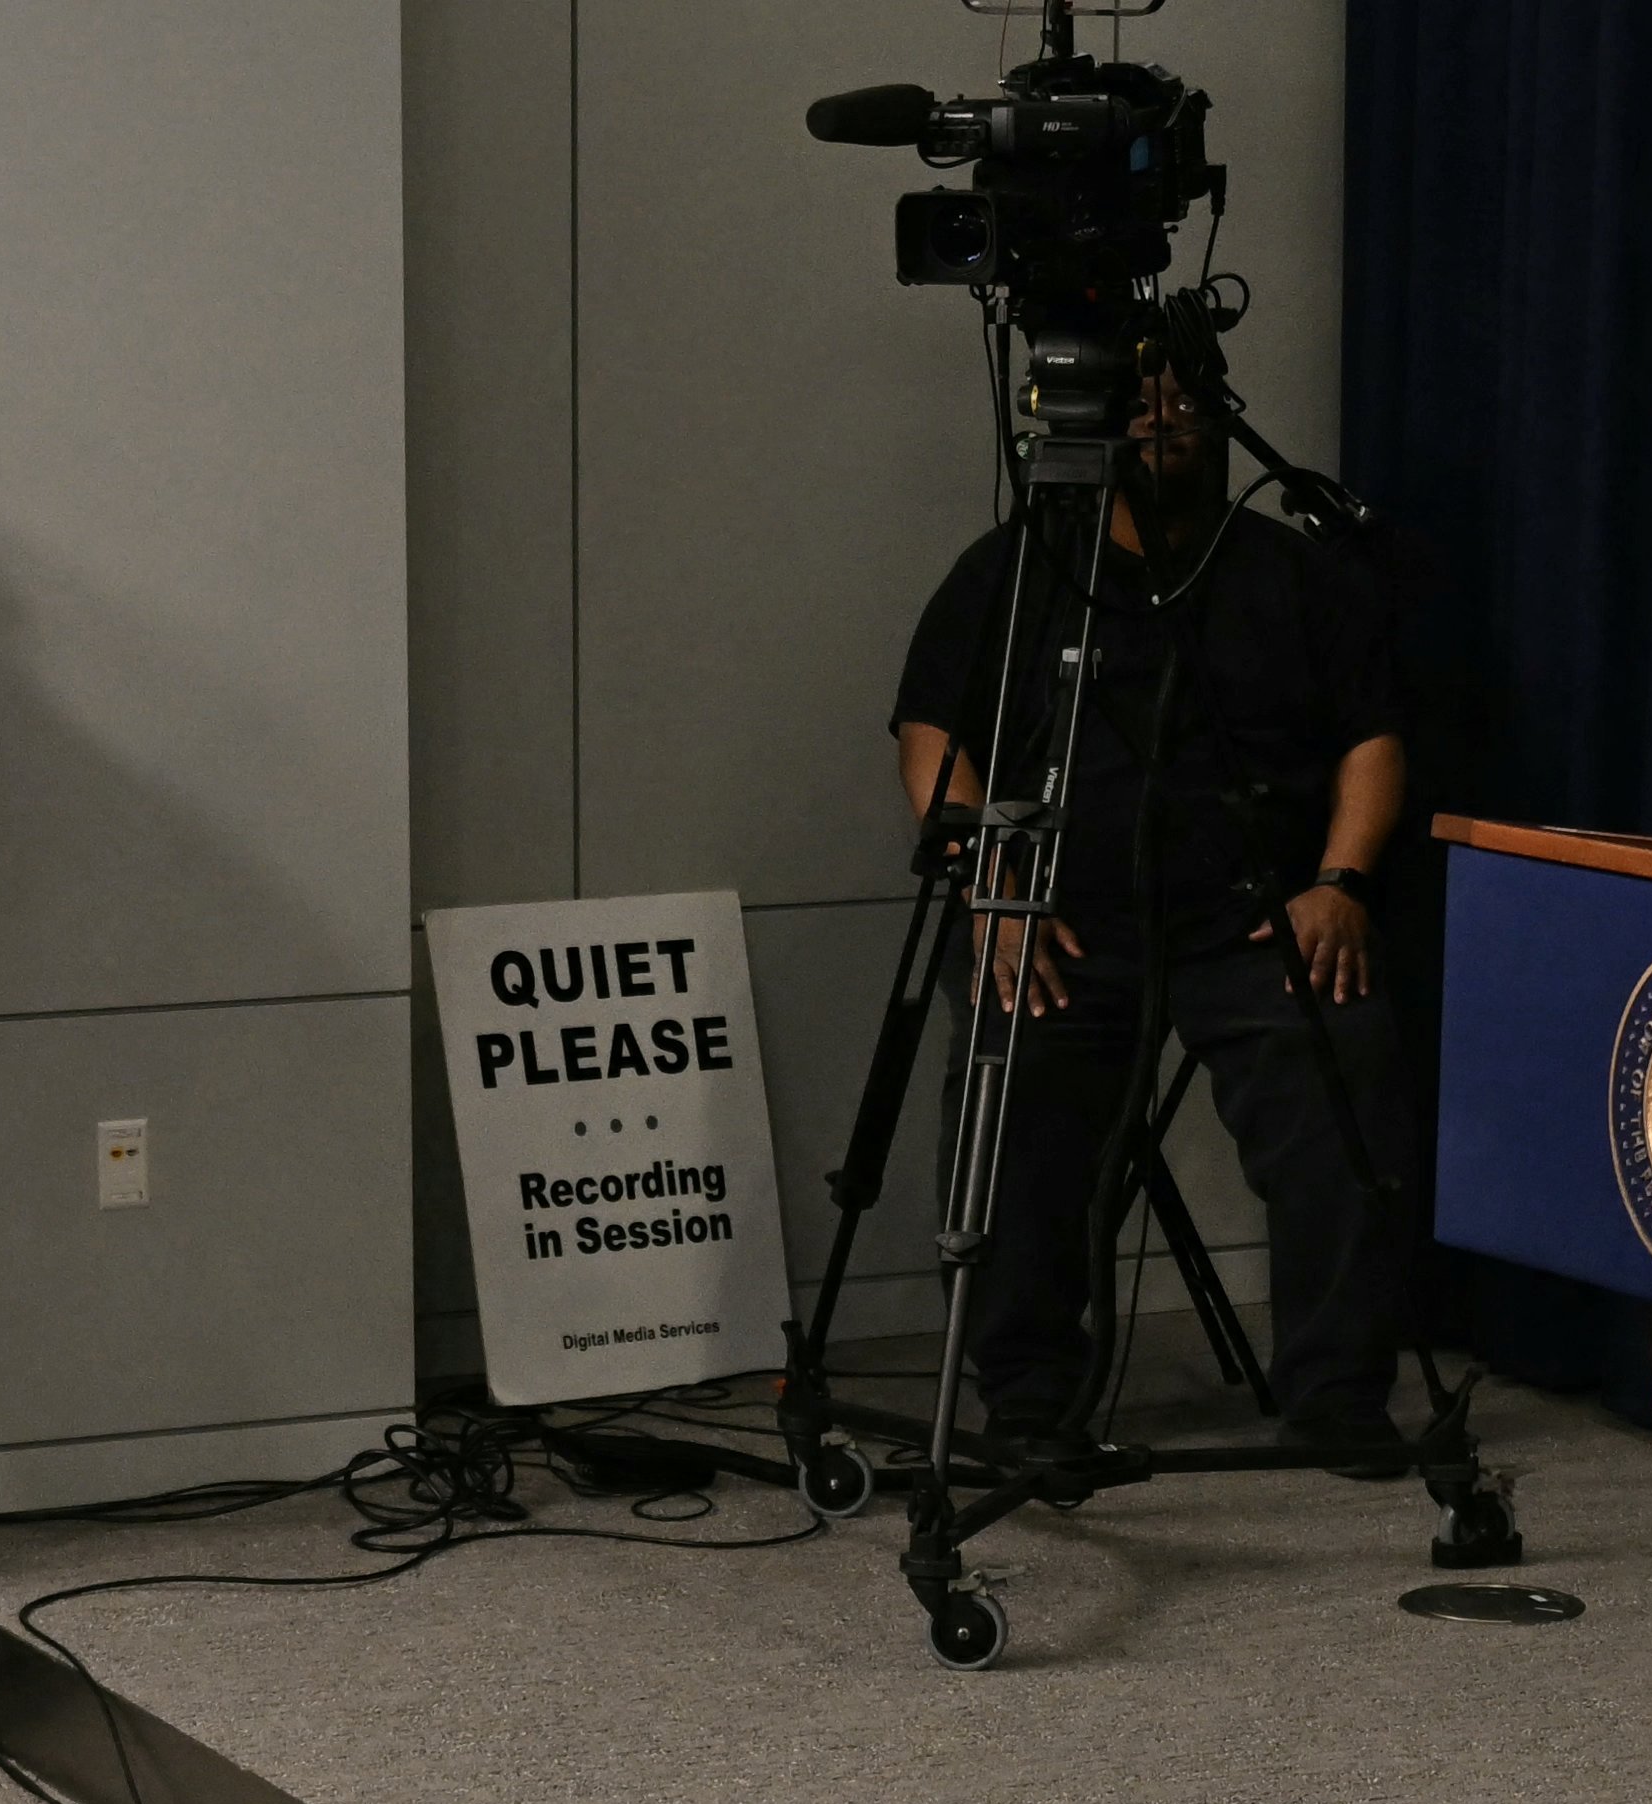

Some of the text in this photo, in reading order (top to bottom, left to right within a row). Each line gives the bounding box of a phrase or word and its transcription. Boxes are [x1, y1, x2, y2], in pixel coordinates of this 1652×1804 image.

[490, 939, 695, 1009] QUIET
[476, 1016, 733, 1089] PLEASE
[520, 1160, 726, 1211] Recording
[525, 1210, 733, 1260] in Session
[562, 1319, 720, 1351] Digital Media Services
